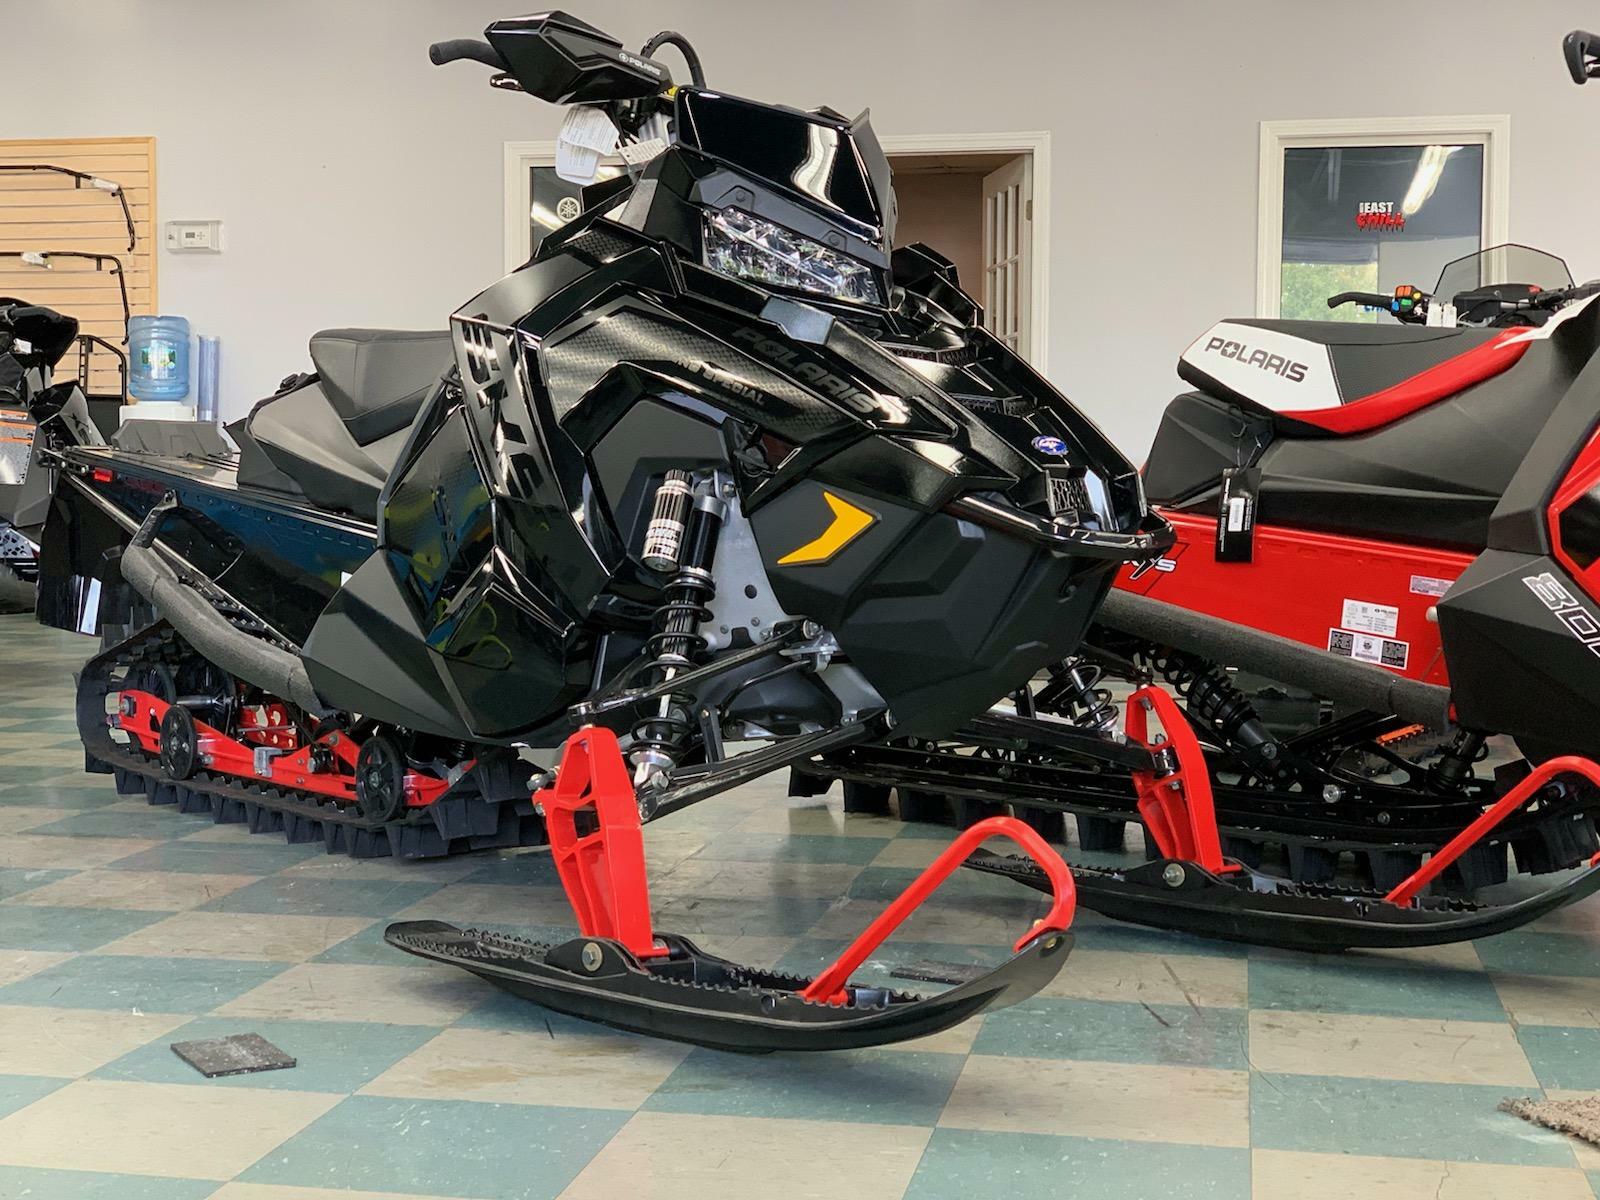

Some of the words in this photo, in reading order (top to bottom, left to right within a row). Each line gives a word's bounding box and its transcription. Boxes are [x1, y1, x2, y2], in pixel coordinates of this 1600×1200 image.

[629, 57, 661, 76] POLARIS
[732, 327, 882, 414] POLARIS
[1204, 336, 1309, 383] POLARIS
